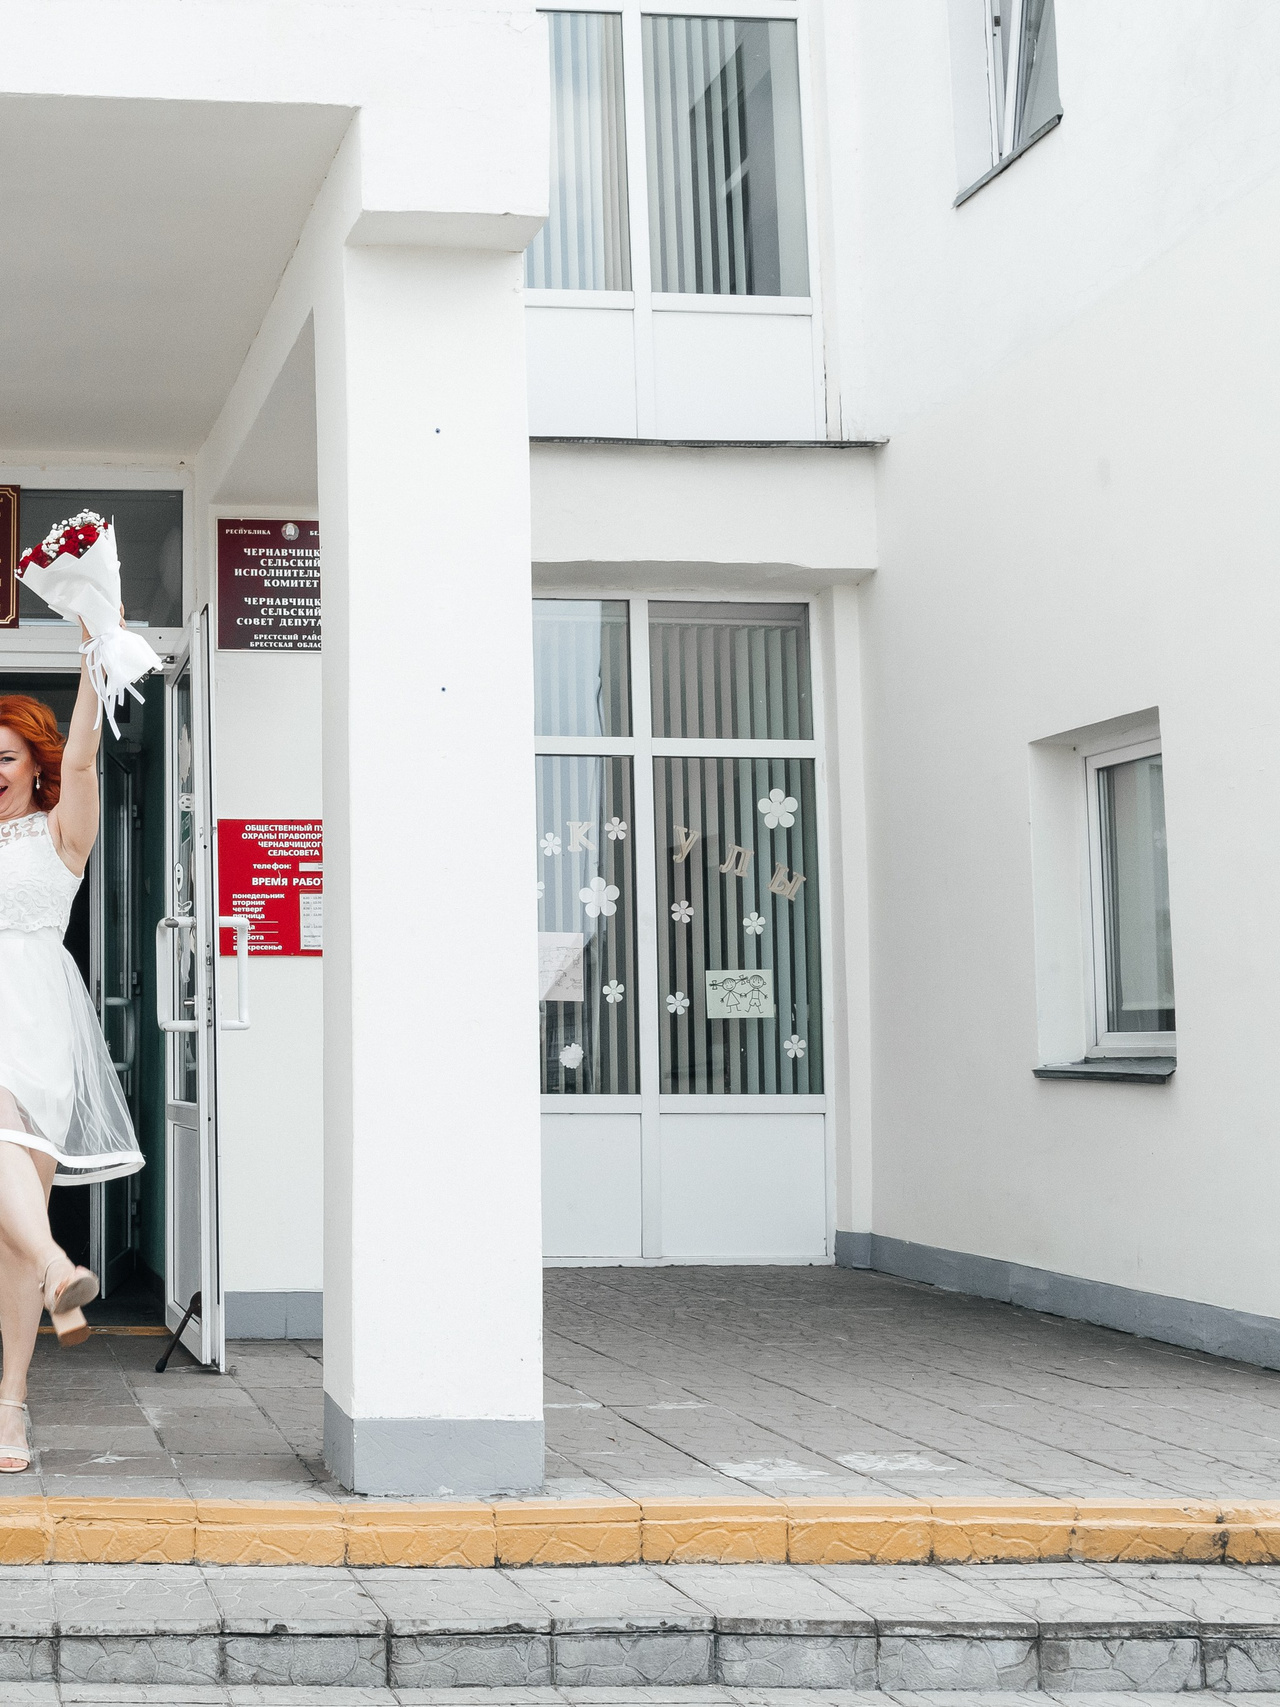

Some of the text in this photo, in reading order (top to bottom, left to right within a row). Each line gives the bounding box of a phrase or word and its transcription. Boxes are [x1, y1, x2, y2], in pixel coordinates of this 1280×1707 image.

[260, 558, 320, 567] СЕЛЬСКИЙ
[264, 579, 319, 587] КОМИТЕТ
[260, 607, 321, 616] СЕЛЬСКИЙ
[236, 617, 274, 626] СОВЕТ
[245, 824, 312, 832] ОБЩЕСТВЕННЫЙ
[258, 841, 323, 849] ЧЕРНАВЧИЦКОГ
[252, 862, 292, 871] телефон:
[252, 877, 288, 886] ВРЕМЯ
